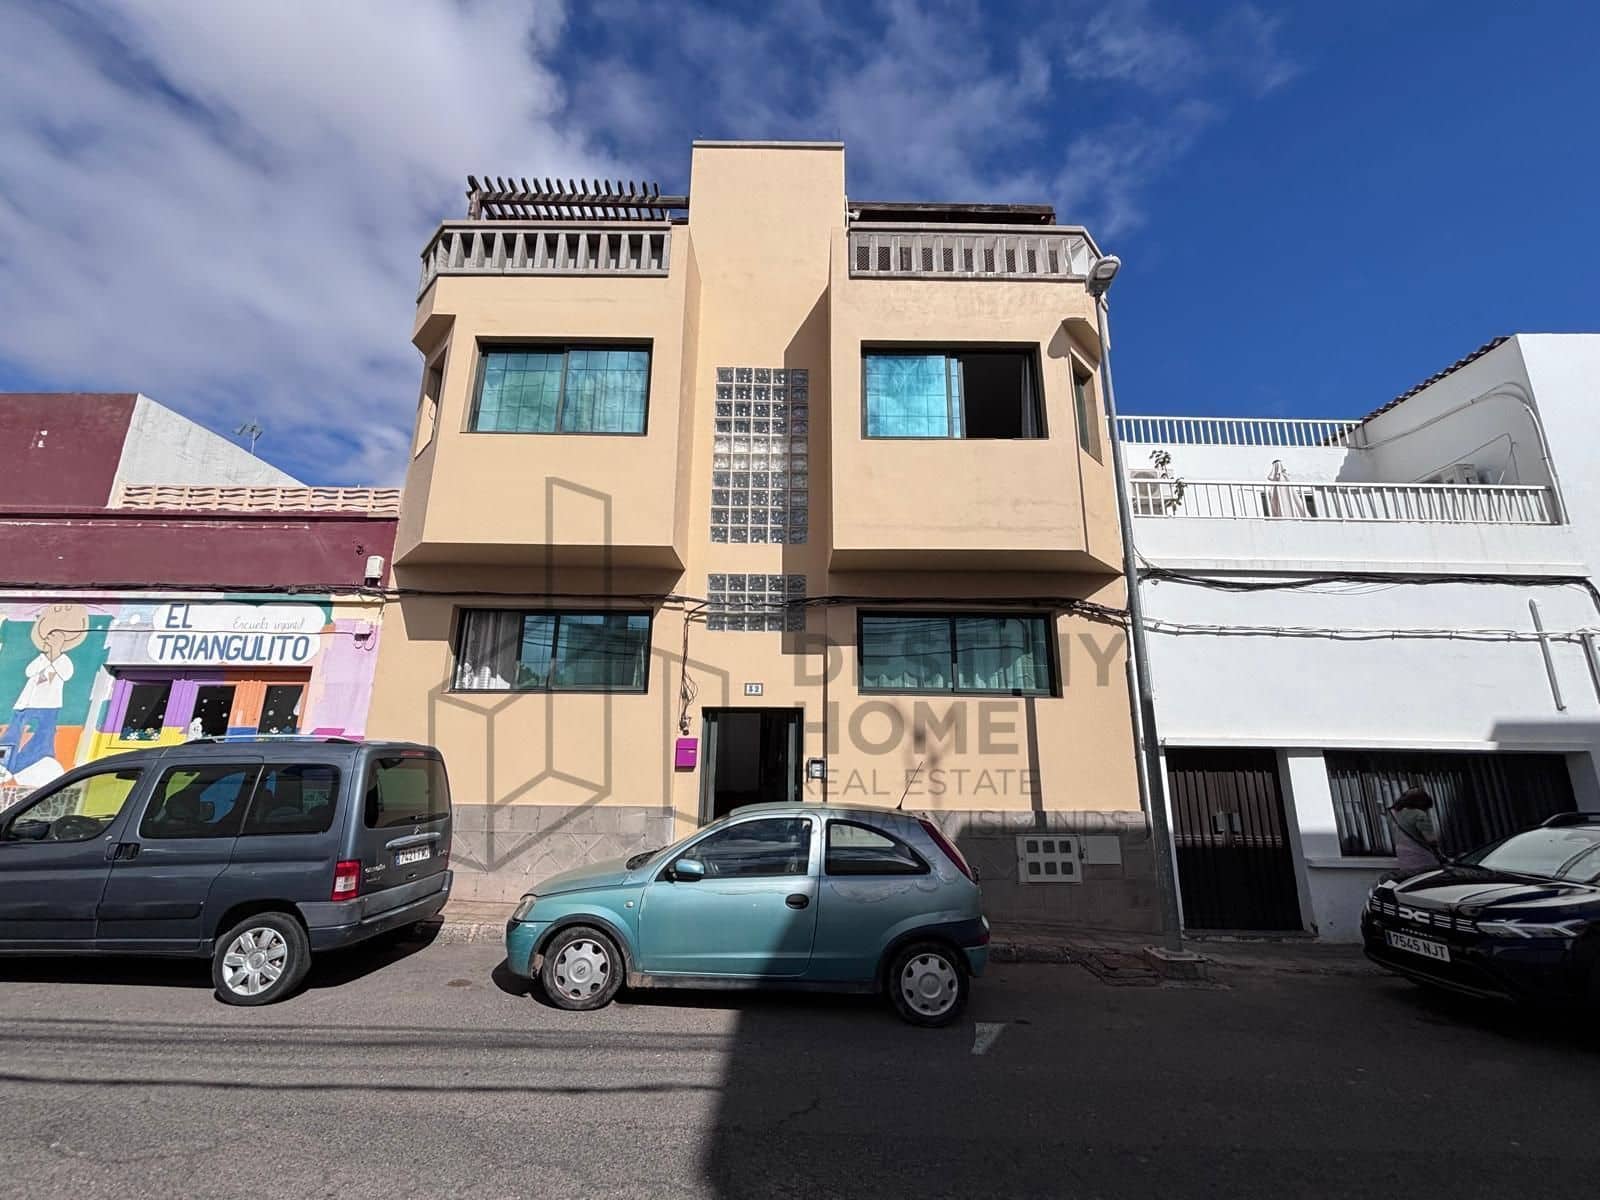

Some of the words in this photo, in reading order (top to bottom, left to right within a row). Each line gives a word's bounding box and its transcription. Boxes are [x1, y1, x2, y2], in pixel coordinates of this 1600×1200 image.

[165, 603, 193, 629] EL
[156, 634, 311, 662] TRIANGULITO
[1392, 933, 1421, 952] 7545
[1422, 941, 1446, 959] NJT
